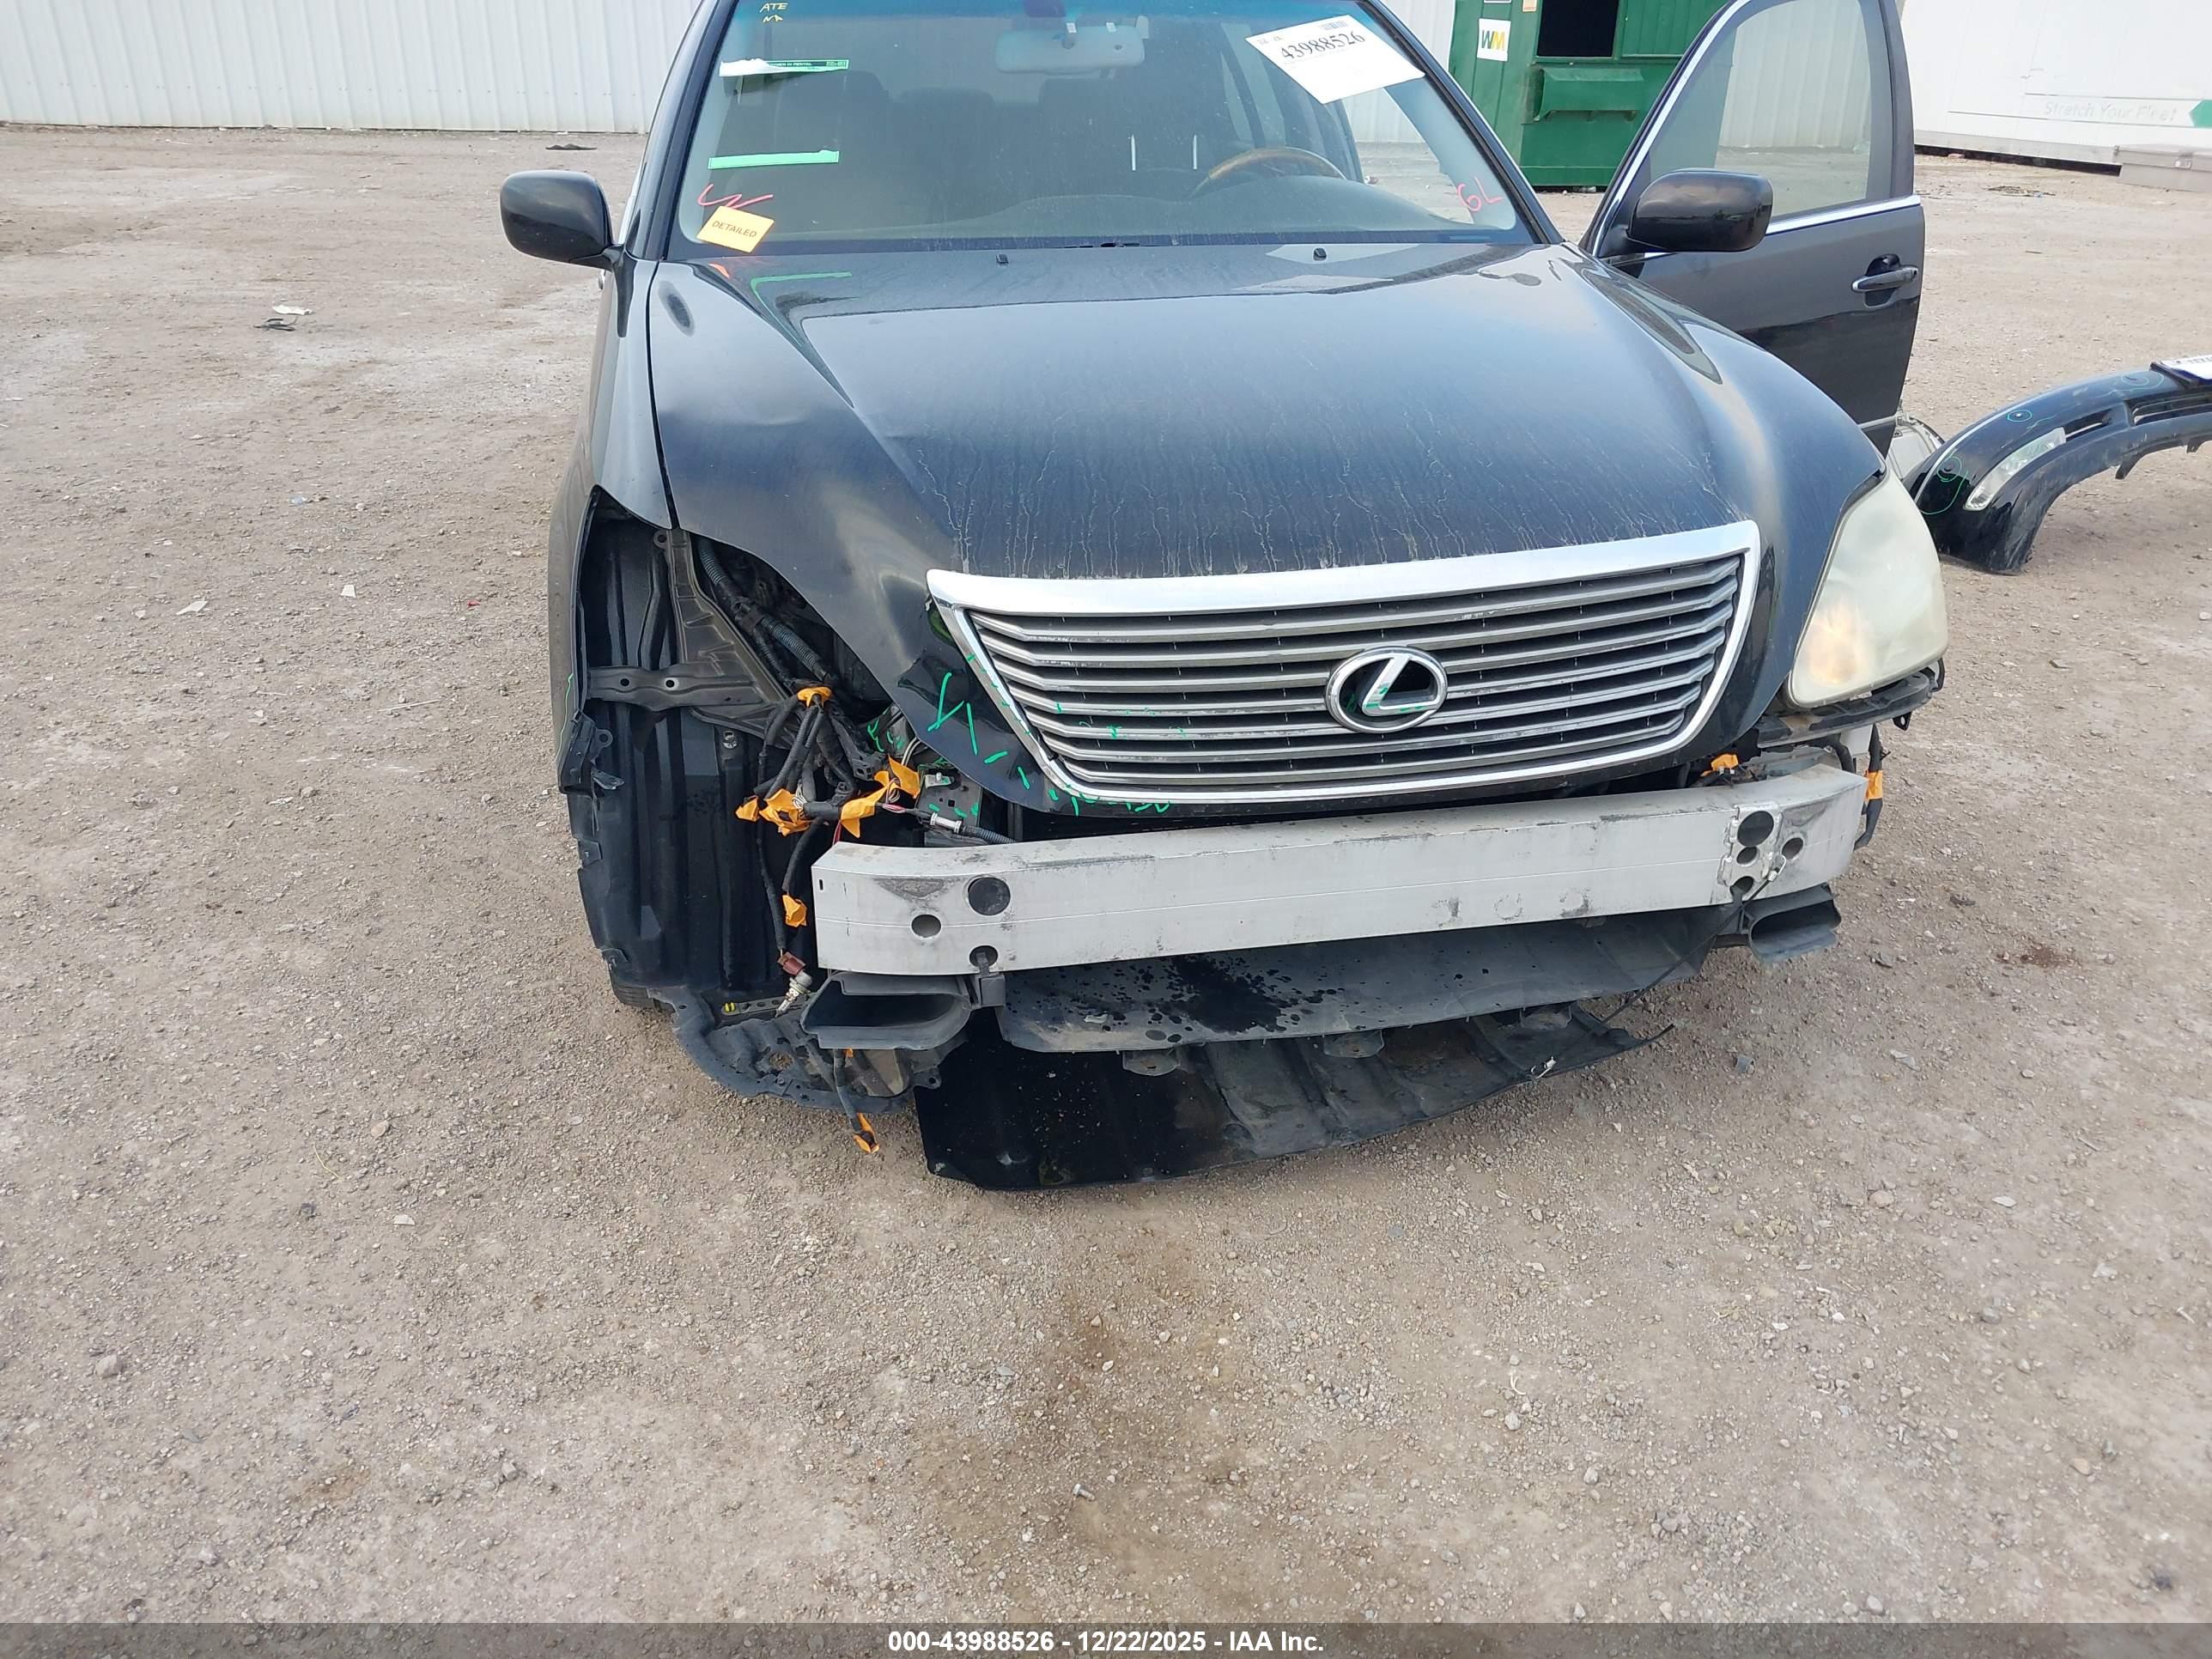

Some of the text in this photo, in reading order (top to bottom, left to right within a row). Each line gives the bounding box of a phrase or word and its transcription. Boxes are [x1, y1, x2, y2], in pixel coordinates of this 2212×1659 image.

[1280, 30, 1366, 60] 43988526
[1481, 29, 1505, 51] WM
[2045, 101, 2096, 118] Stretch
[2100, 102, 2133, 119] Your
[712, 220, 757, 238] DETAILED
